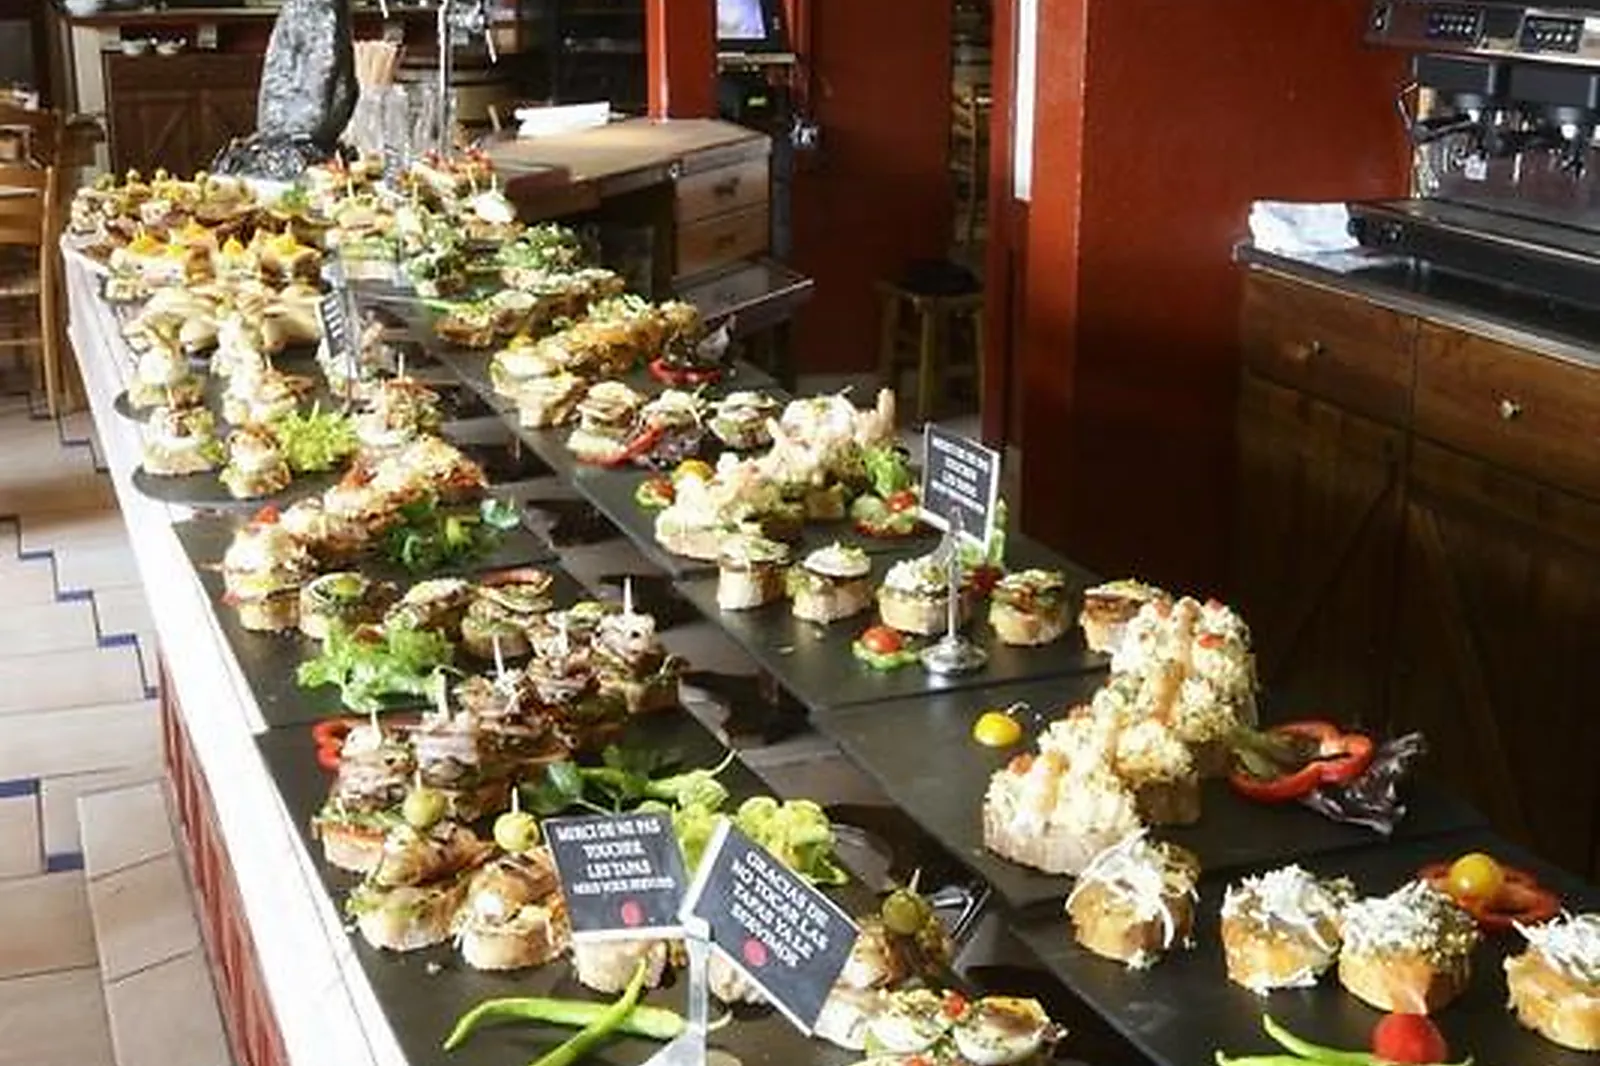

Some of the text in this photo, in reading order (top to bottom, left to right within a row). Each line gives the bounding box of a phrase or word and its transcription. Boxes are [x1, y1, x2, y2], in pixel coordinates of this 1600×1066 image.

[731, 858, 829, 951] NO TOCAR LAS
[732, 880, 775, 924] TAPAS
[774, 919, 793, 943] YA
[746, 850, 830, 928] GRACIAS DE
